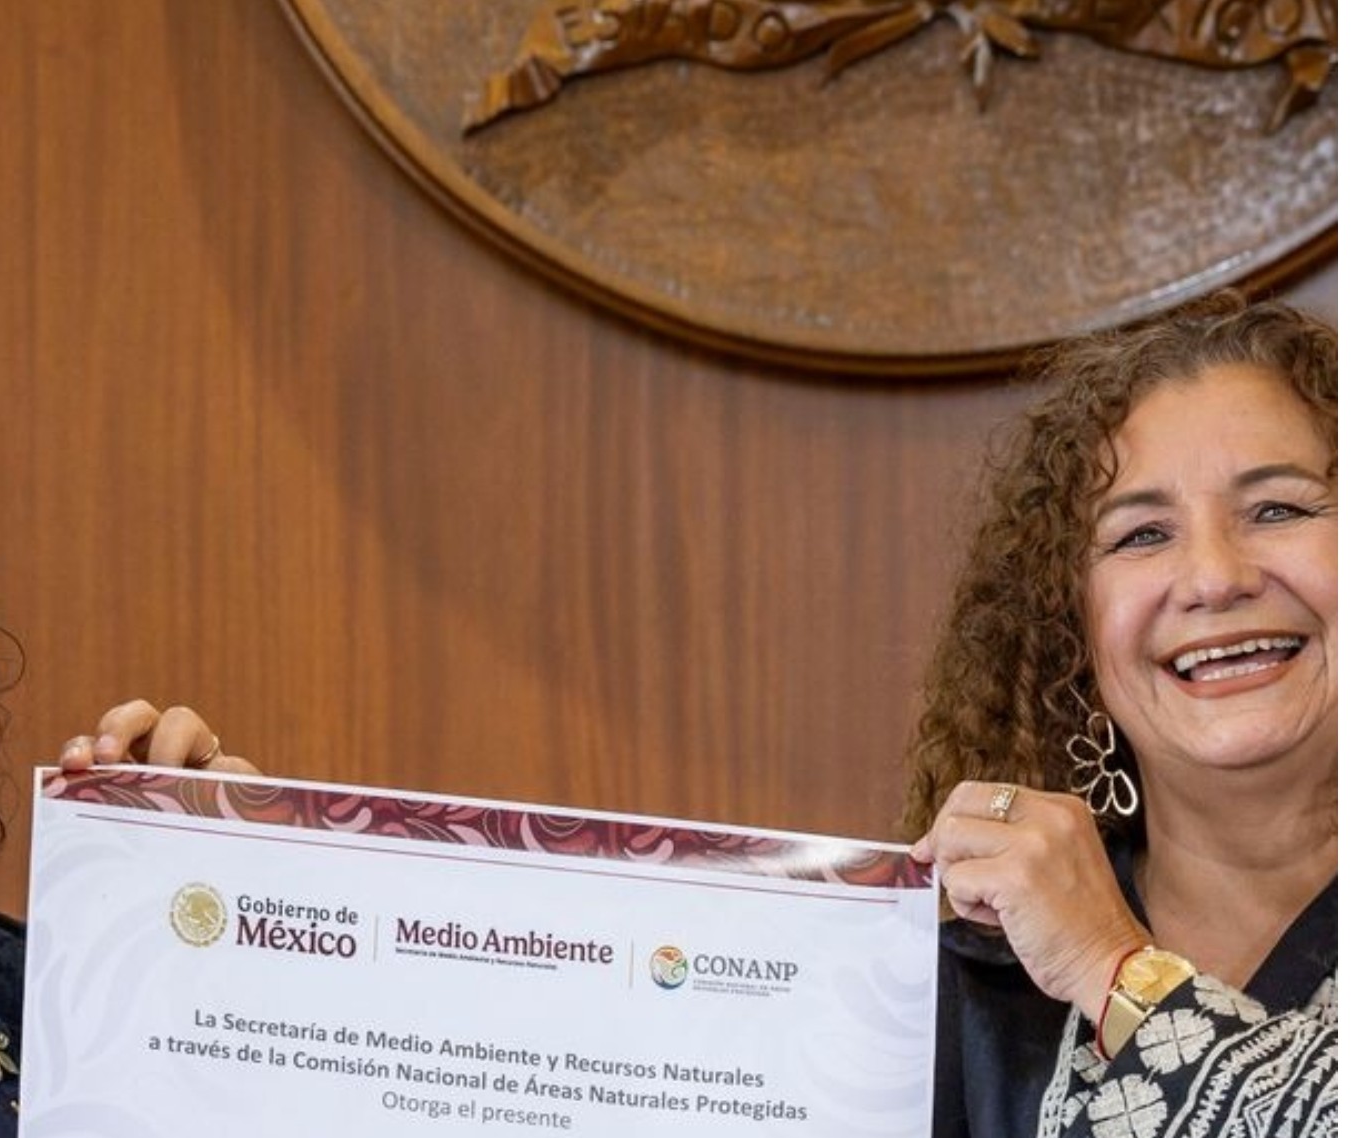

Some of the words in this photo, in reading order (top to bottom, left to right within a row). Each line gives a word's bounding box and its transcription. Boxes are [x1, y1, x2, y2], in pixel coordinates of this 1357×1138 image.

[238, 895, 330, 921] Gobierno
[336, 907, 358, 925] de
[236, 914, 356, 958] México
[396, 918, 478, 950] Medio
[482, 928, 613, 964] Ambiente
[693, 954, 798, 981] CONANP
[195, 1009, 216, 1028] La
[223, 1013, 327, 1042] Secretaría
[333, 1027, 359, 1046] de
[366, 1030, 433, 1054] Medio
[439, 1039, 541, 1066] Ambiente
[547, 1055, 558, 1074] y
[565, 1053, 656, 1079] Recursos
[664, 1063, 764, 1088] Naturales
[149, 1036, 161, 1050] a
[167, 1036, 230, 1059] través
[237, 1044, 262, 1063] de
[269, 1046, 286, 1066] la
[293, 1051, 390, 1078] Comisión
[396, 1063, 487, 1090] Nacional
[493, 1074, 519, 1093] de
[524, 1074, 583, 1101] Áreas
[589, 1085, 689, 1110] Naturales
[696, 1095, 807, 1121] Protegidas
[382, 1091, 451, 1118] Otorga
[458, 1100, 476, 1118] el
[482, 1107, 571, 1129] presente
